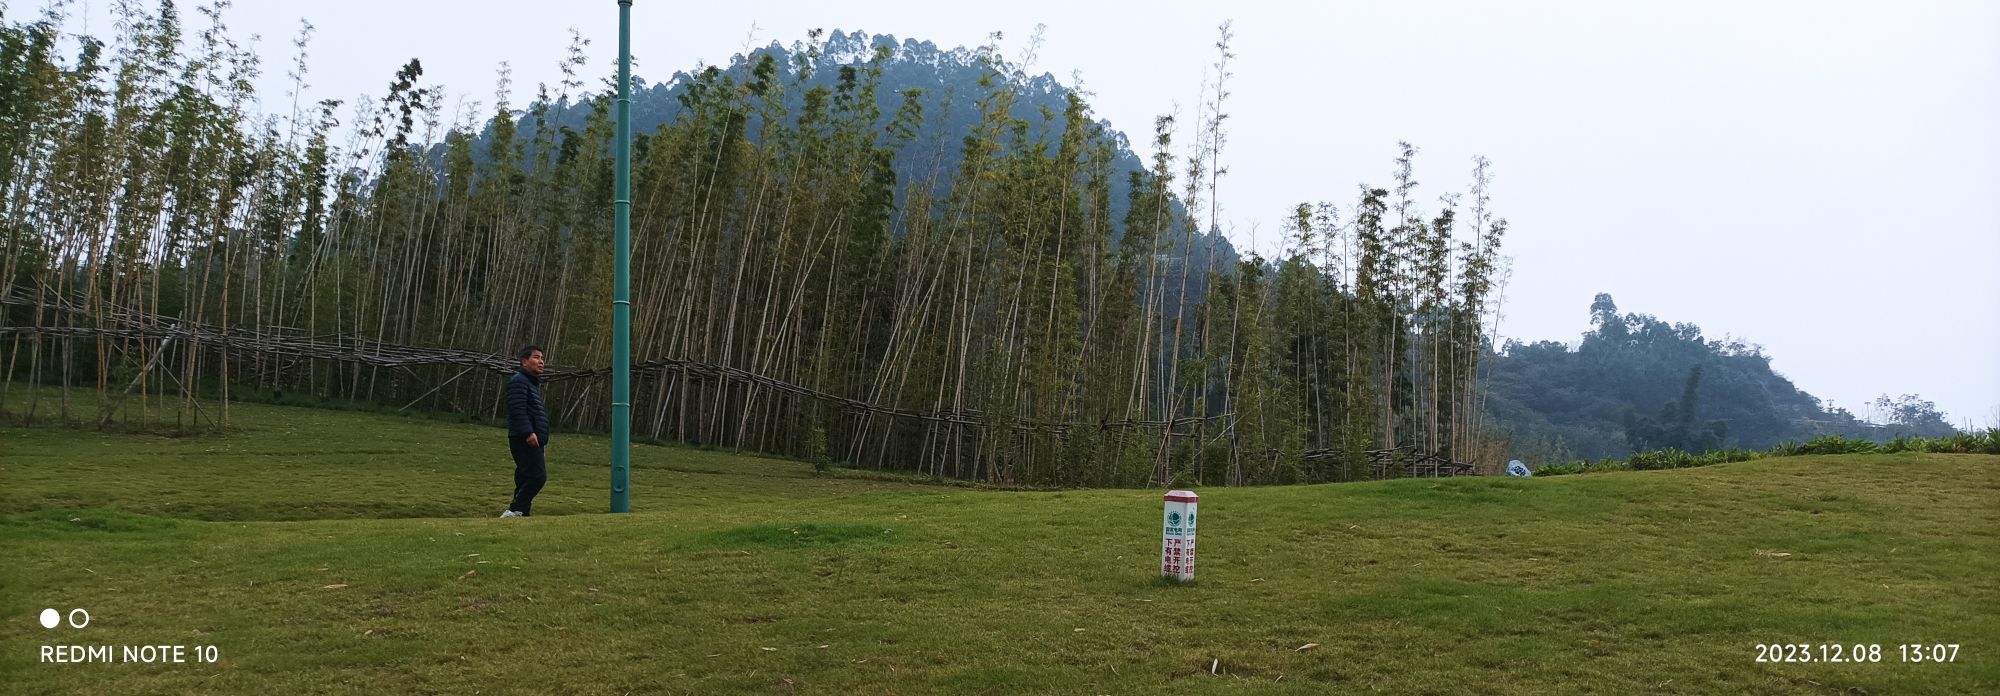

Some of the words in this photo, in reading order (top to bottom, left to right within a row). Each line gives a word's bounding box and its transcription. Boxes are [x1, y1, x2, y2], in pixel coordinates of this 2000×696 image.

[1164, 539, 1173, 573] 下有电缆
[1172, 539, 1181, 574] 严禁开挖
